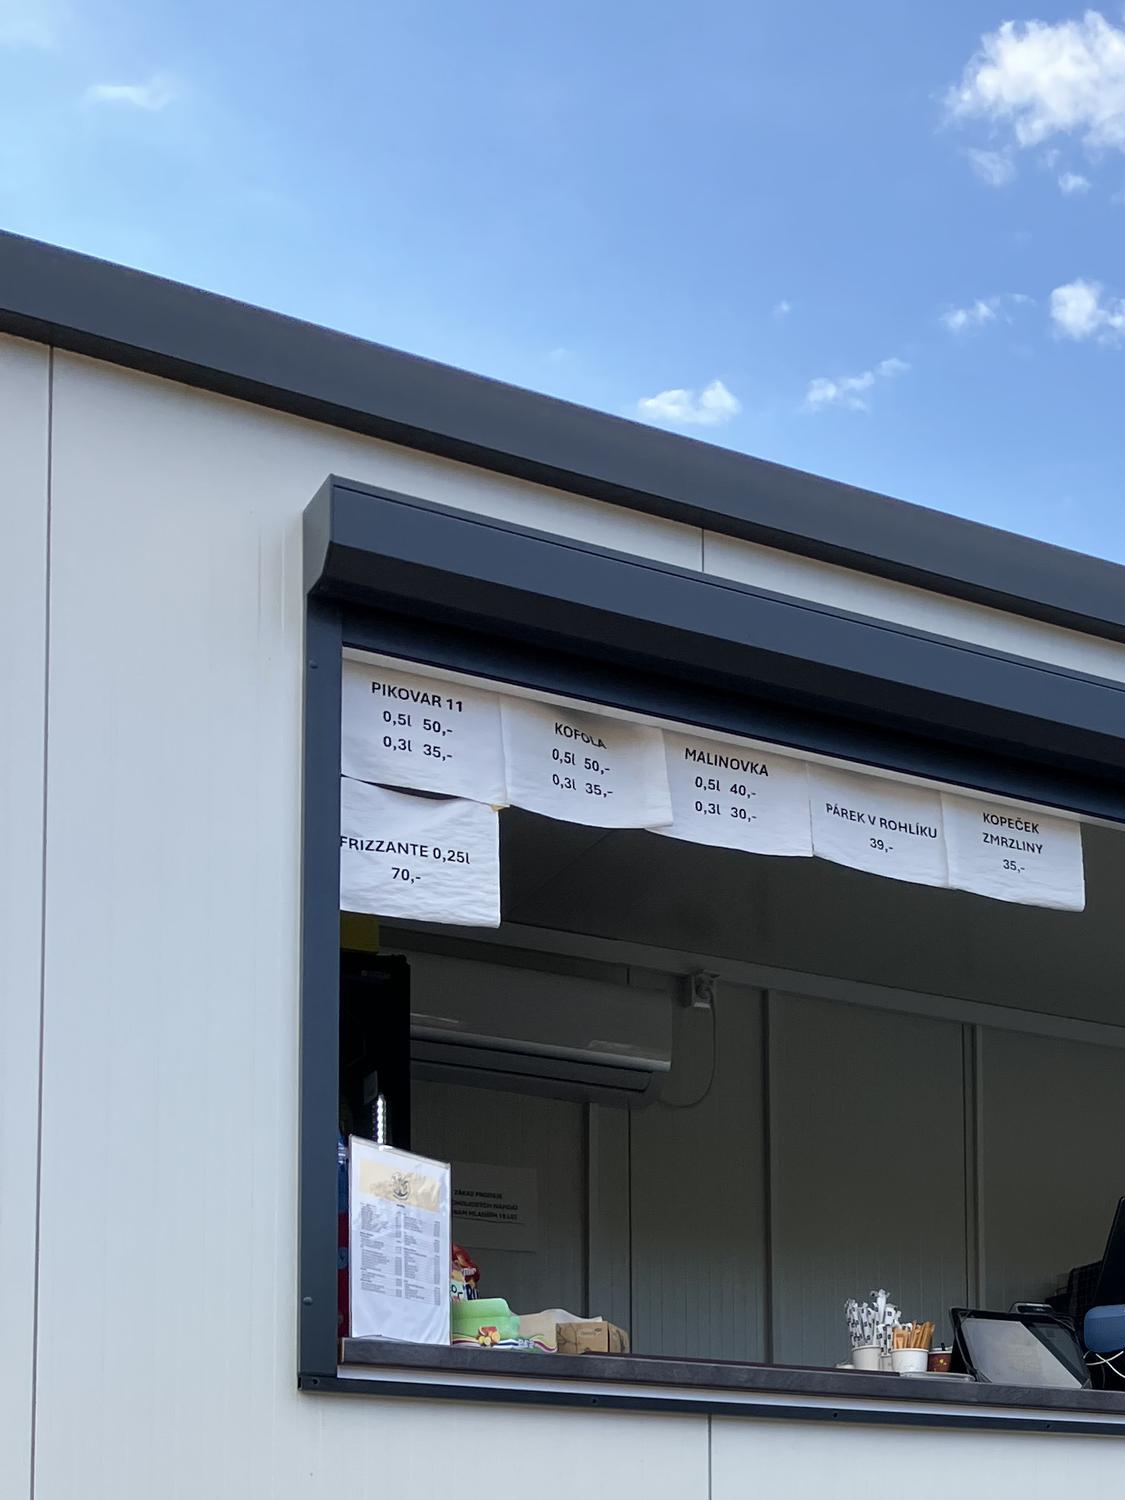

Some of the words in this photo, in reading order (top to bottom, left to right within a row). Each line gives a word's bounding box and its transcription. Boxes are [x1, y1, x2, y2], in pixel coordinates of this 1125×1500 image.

[372, 682, 441, 708] PIKOVAR
[447, 699, 462, 712] 11
[383, 711, 411, 726] 0,5l
[423, 719, 452, 736] 50,-
[554, 722, 607, 749] KOFOLA
[383, 736, 412, 752] 0,3l
[424, 744, 452, 761] 35,-
[552, 748, 575, 765] 0,5l
[585, 758, 610, 774] 50,-
[685, 747, 769, 777] MALINOVKA
[553, 774, 576, 790] 0,3l
[586, 783, 613, 798] 35,-
[695, 777, 720, 791] 0,5l
[730, 784, 755, 798] 40,-
[695, 801, 720, 815] 0,3l
[731, 807, 756, 822] 30,-
[826, 803, 865, 823] PÁREK
[868, 815, 876, 825] V
[880, 818, 937, 838] ROHLÍKU
[983, 811, 1040, 834] KOPEČEK
[340, 836, 428, 858] FRIZZANTE
[433, 848, 470, 864] 0,25l
[870, 838, 893, 853] 39,-
[983, 832, 1042, 854] ZMRZLINY
[392, 867, 420, 884] 70,-
[1003, 859, 1024, 873] 35,-
